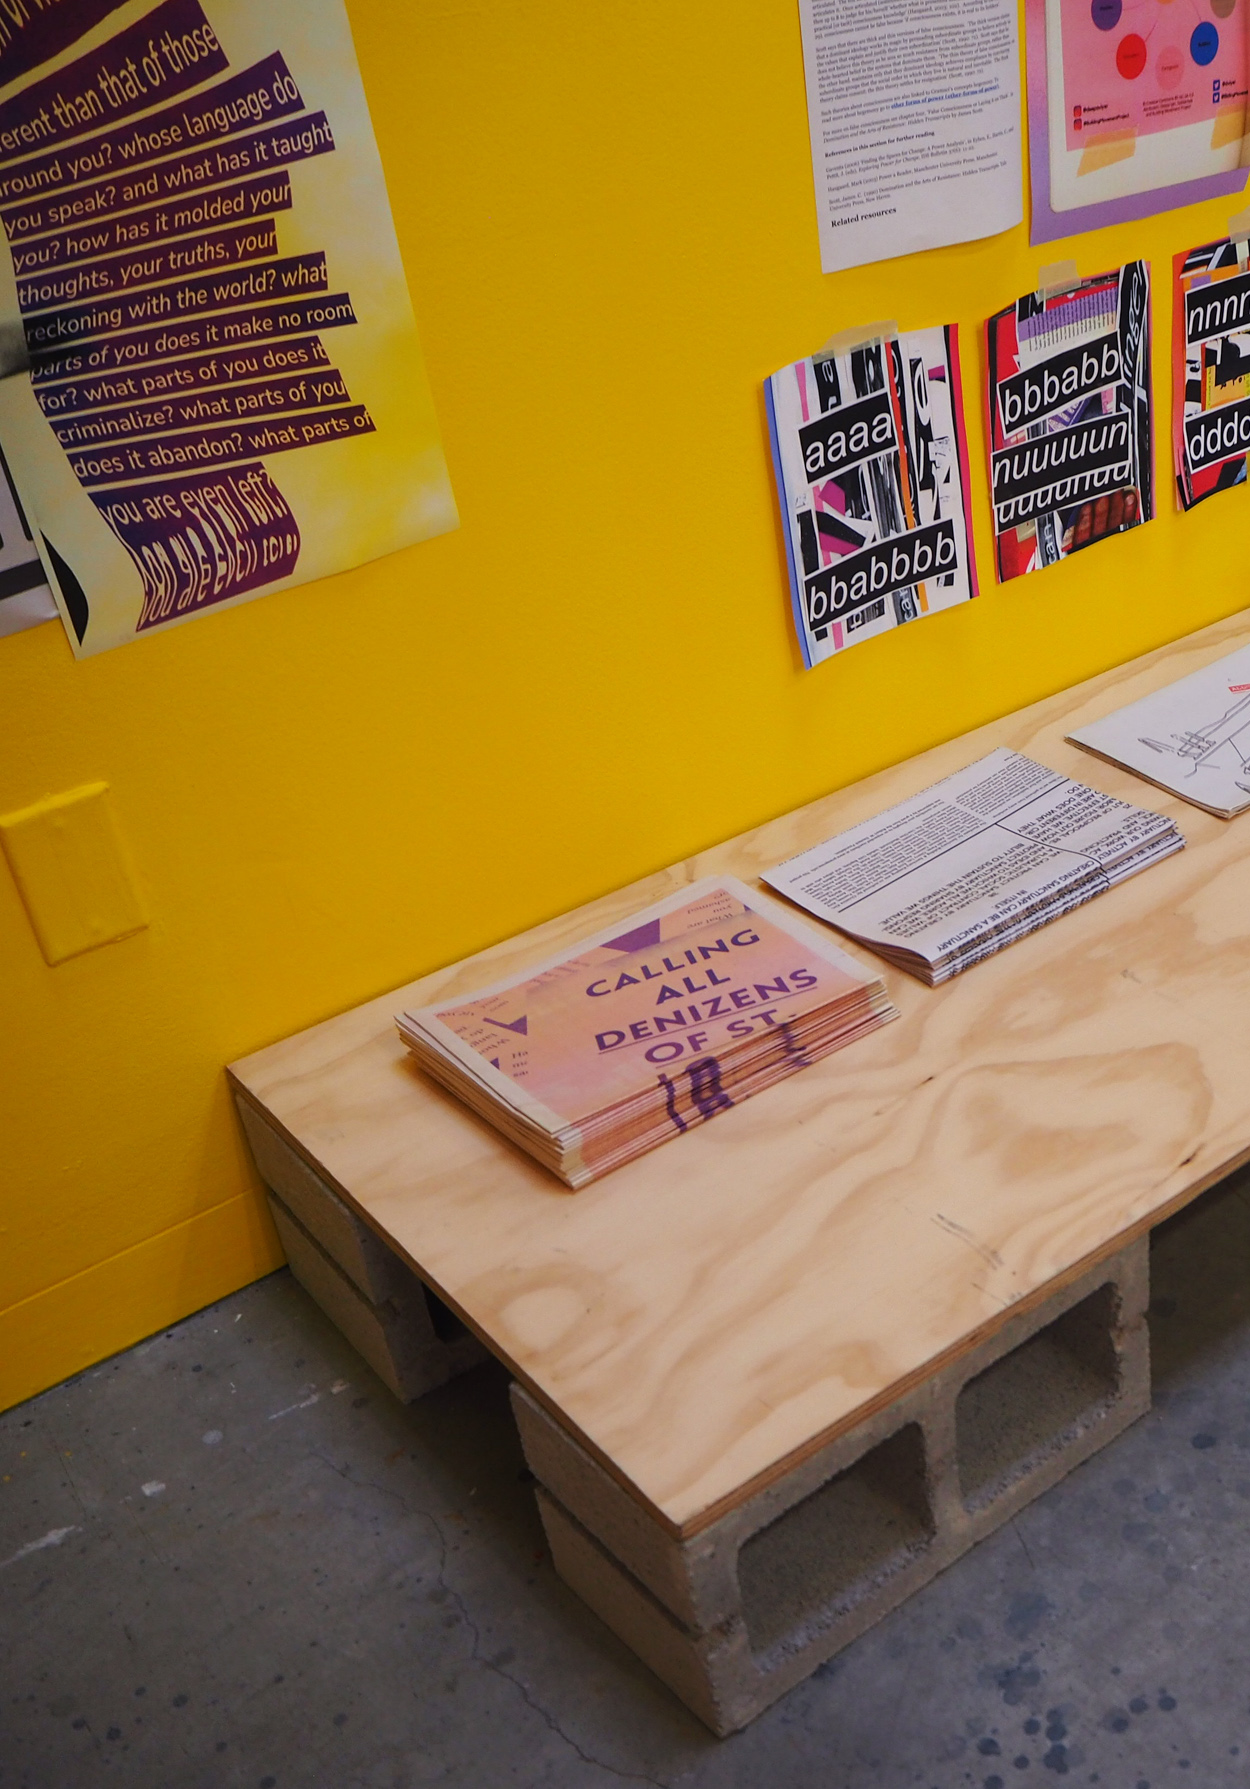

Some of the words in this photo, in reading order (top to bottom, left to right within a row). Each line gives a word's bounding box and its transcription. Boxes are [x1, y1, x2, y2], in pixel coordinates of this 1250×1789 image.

[0, 108, 56, 150] erent
[52, 93, 104, 129] than
[98, 57, 147, 108] that
[142, 40, 166, 87] of
[161, 24, 219, 74] those
[0, 160, 63, 198] round
[67, 143, 112, 180] you?
[118, 126, 183, 159] whose
[183, 88, 272, 137] language
[273, 71, 299, 105] do
[5, 212, 42, 239] you
[48, 186, 116, 224] speak?
[123, 173, 159, 201] and
[164, 159, 213, 189] what
[217, 150, 251, 174] has
[254, 141, 269, 163] it
[271, 121, 333, 157] taught
[13, 241, 60, 273] you?
[66, 232, 110, 256] how
[116, 221, 150, 243] has
[155, 213, 169, 233] it
[174, 190, 245, 229] molded
[250, 184, 291, 213] your
[831, 213, 859, 228] Related
[861, 207, 897, 220] resources
[18, 271, 115, 306] thoughts,
[120, 257, 164, 286] your
[168, 241, 230, 270] truths,
[236, 231, 277, 258] your
[27, 306, 122, 342] reckoning
[128, 293, 171, 319] with
[177, 287, 207, 309] the
[213, 269, 277, 301] world?
[281, 261, 328, 288] what
[89, 345, 110, 366] of
[114, 342, 149, 365] you
[155, 331, 200, 353] does
[206, 324, 219, 343] it
[224, 316, 274, 339] make
[278, 312, 301, 329] no
[306, 303, 353, 324] room
[38, 387, 78, 412] for?
[84, 378, 138, 402] what
[142, 369, 195, 395] parts
[199, 360, 218, 380] of
[223, 358, 259, 380] you
[263, 347, 308, 369] does
[311, 342, 328, 361] it
[1005, 343, 1119, 425] bbbabb
[57, 405, 174, 443] criminalize?
[180, 396, 231, 421] what
[235, 388, 285, 415] parts
[289, 381, 307, 402] of
[311, 380, 346, 403] you
[74, 457, 124, 478] does
[127, 449, 146, 470] it
[149, 433, 243, 467] abandon?
[248, 425, 300, 449] what
[302, 417, 350, 442] parts
[354, 410, 371, 428] of
[805, 412, 892, 474] aaaa
[994, 420, 1127, 487] nuuuuun
[99, 499, 144, 527] you
[143, 493, 182, 520] are
[180, 484, 231, 515] even
[228, 469, 274, 507] left?
[810, 531, 954, 622] bbabbbb
[1012, 879, 1062, 905] SANCTUARY
[1056, 860, 1097, 881] CREATING
[932, 922, 985, 951] SANCTUARY
[986, 913, 1001, 921] BE
[996, 903, 1019, 915] CAN
[586, 928, 761, 997] CALLING
[656, 968, 731, 1005] ALL
[595, 968, 818, 1051] DENIZENS
[645, 1031, 709, 1063] OF
